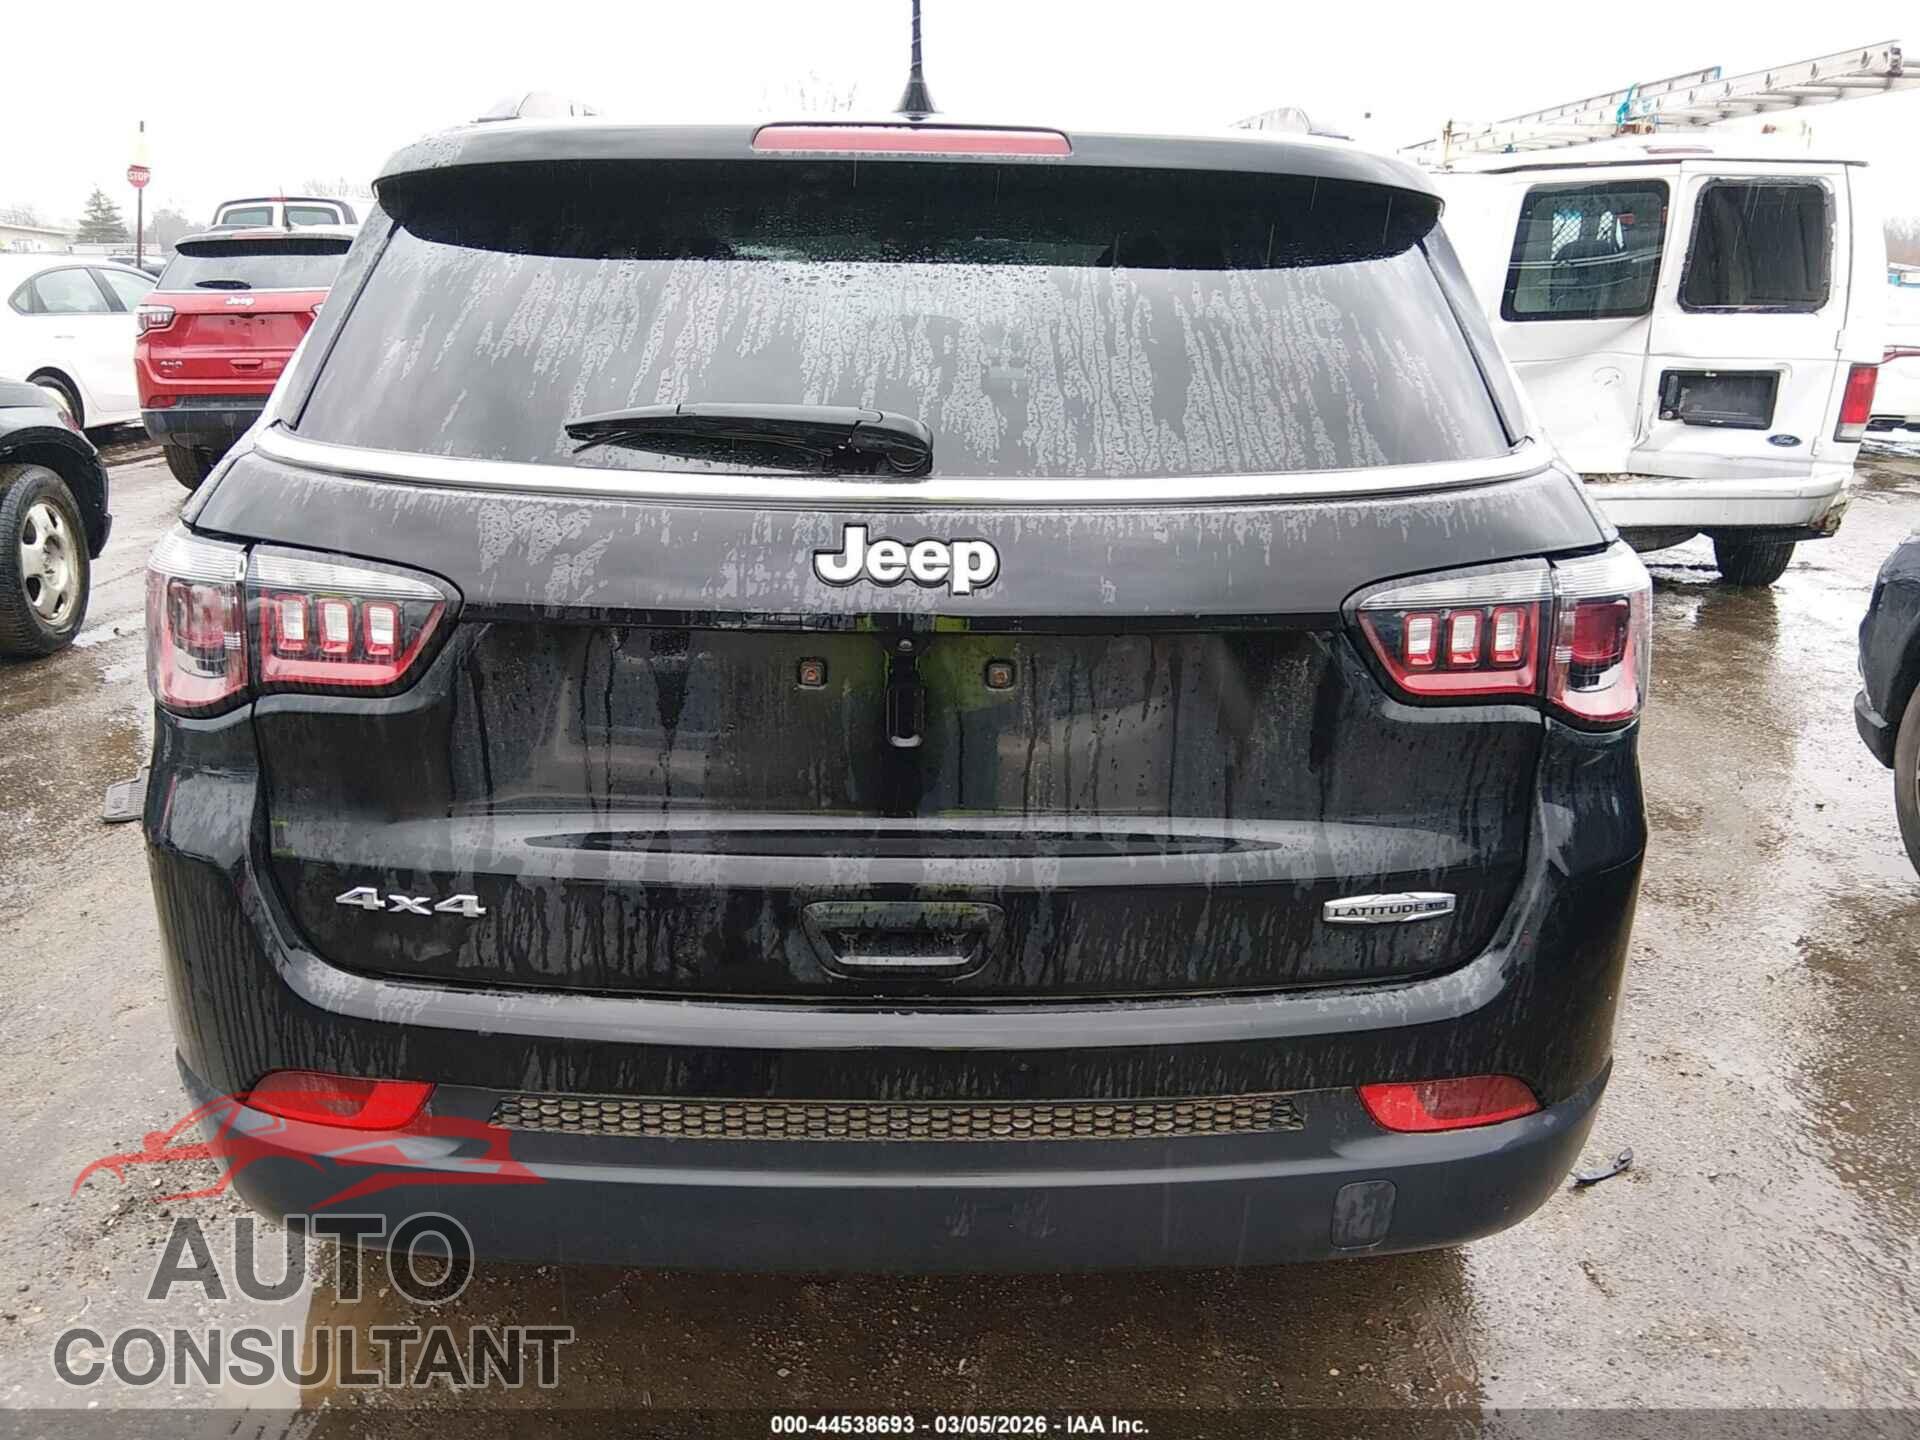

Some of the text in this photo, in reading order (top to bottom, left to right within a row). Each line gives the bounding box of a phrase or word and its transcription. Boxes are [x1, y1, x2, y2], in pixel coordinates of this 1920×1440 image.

[127, 171, 150, 182] STOP
[226, 295, 254, 306] Jeep
[814, 524, 998, 596] Jeep
[336, 886, 487, 918] 4x4
[1333, 904, 1424, 917] LATITUDE
